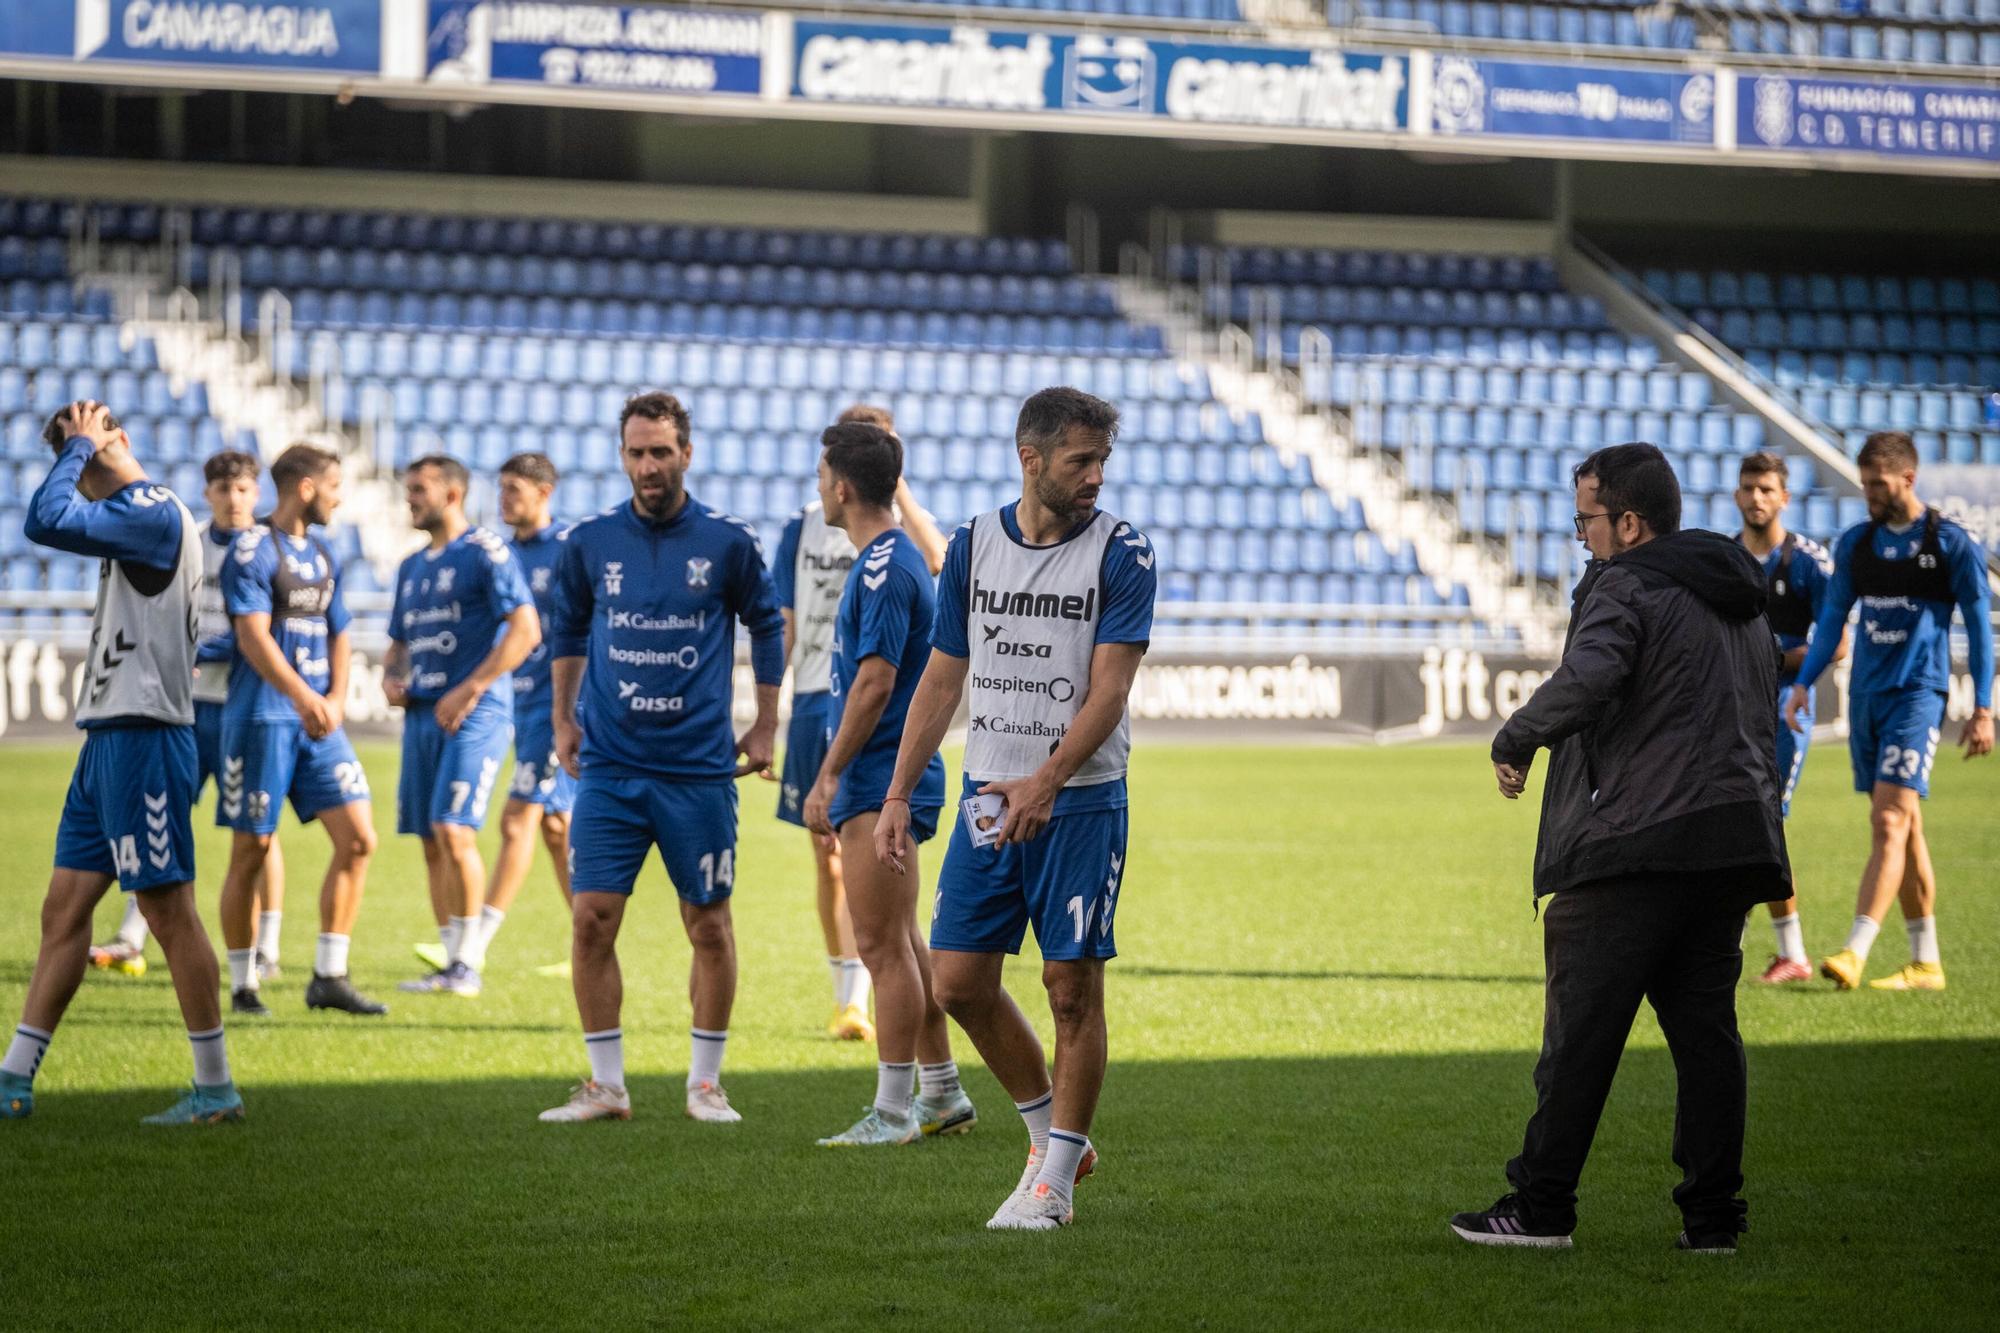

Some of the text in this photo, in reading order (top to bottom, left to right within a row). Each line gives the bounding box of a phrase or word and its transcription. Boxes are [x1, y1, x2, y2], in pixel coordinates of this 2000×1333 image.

[972, 579, 1096, 622] hummel
[630, 613, 697, 630] CaixaBank
[609, 644, 680, 667] hospiten
[972, 673, 1047, 694] hospiten
[990, 716, 1068, 737] CaixaBank
[1881, 744, 1921, 780] 23
[698, 848, 733, 892] 14
